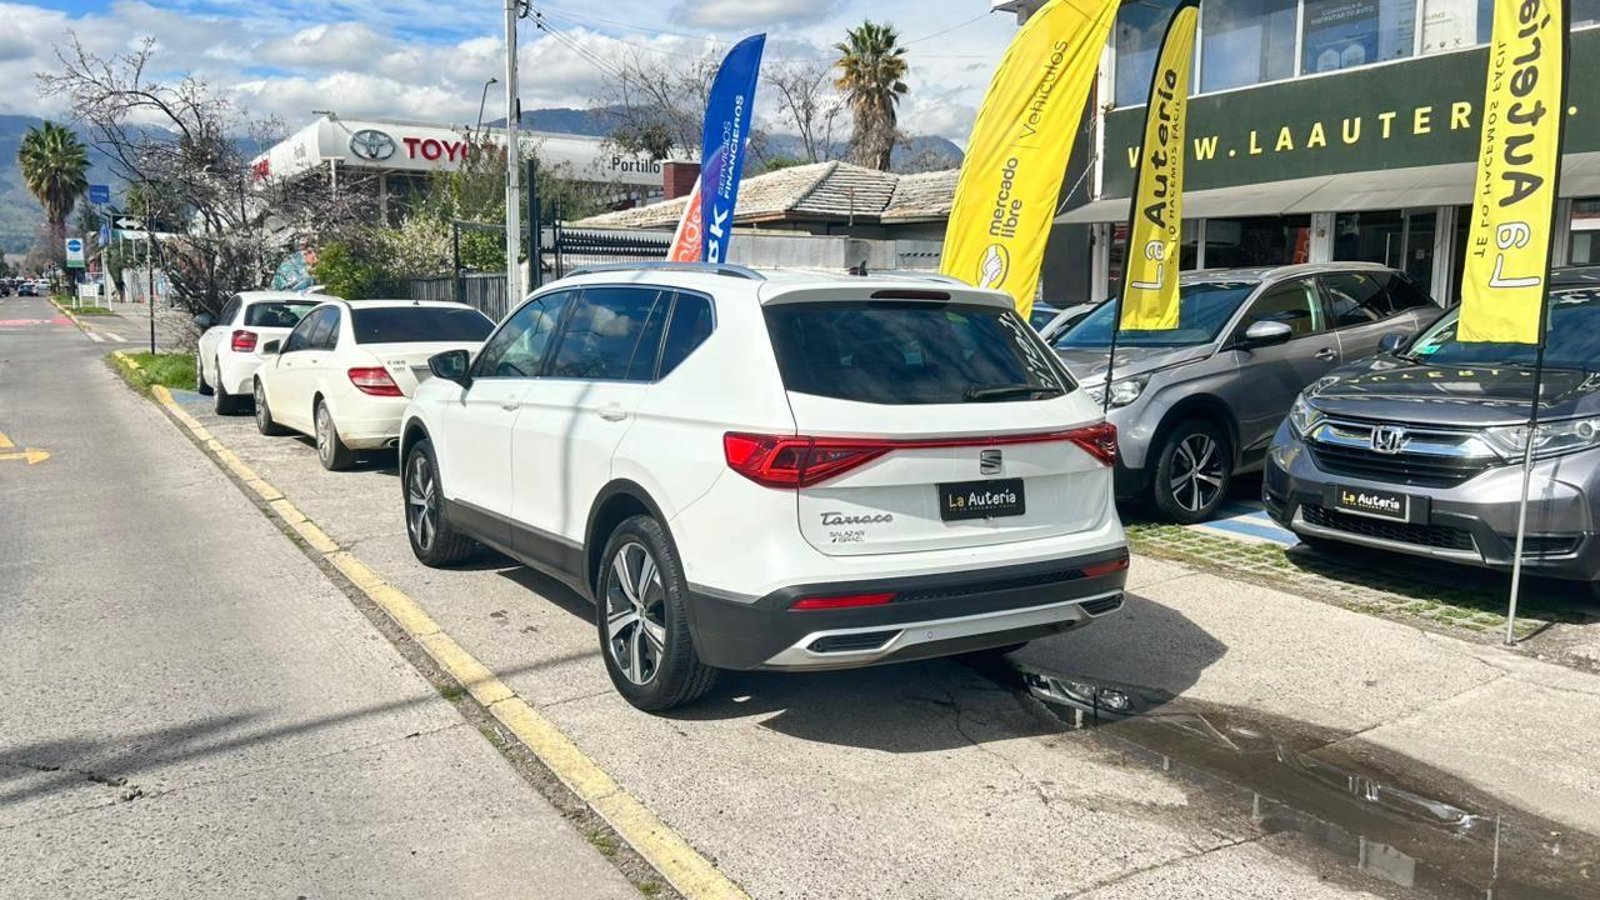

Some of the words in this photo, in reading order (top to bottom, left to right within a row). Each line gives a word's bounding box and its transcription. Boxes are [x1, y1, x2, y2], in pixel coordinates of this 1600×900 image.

[718, 120, 732, 197] SERVICIOS
[724, 95, 745, 200] FINANCIEROS
[988, 156, 1019, 237] mercado
[1169, 147, 1178, 221] HACEMOS
[1000, 198, 1023, 239] libre
[1131, 240, 1165, 290] La
[820, 511, 894, 527] Tarraco
[949, 494, 965, 508] La
[968, 489, 1016, 507] Autería
[1343, 491, 1356, 502] La
